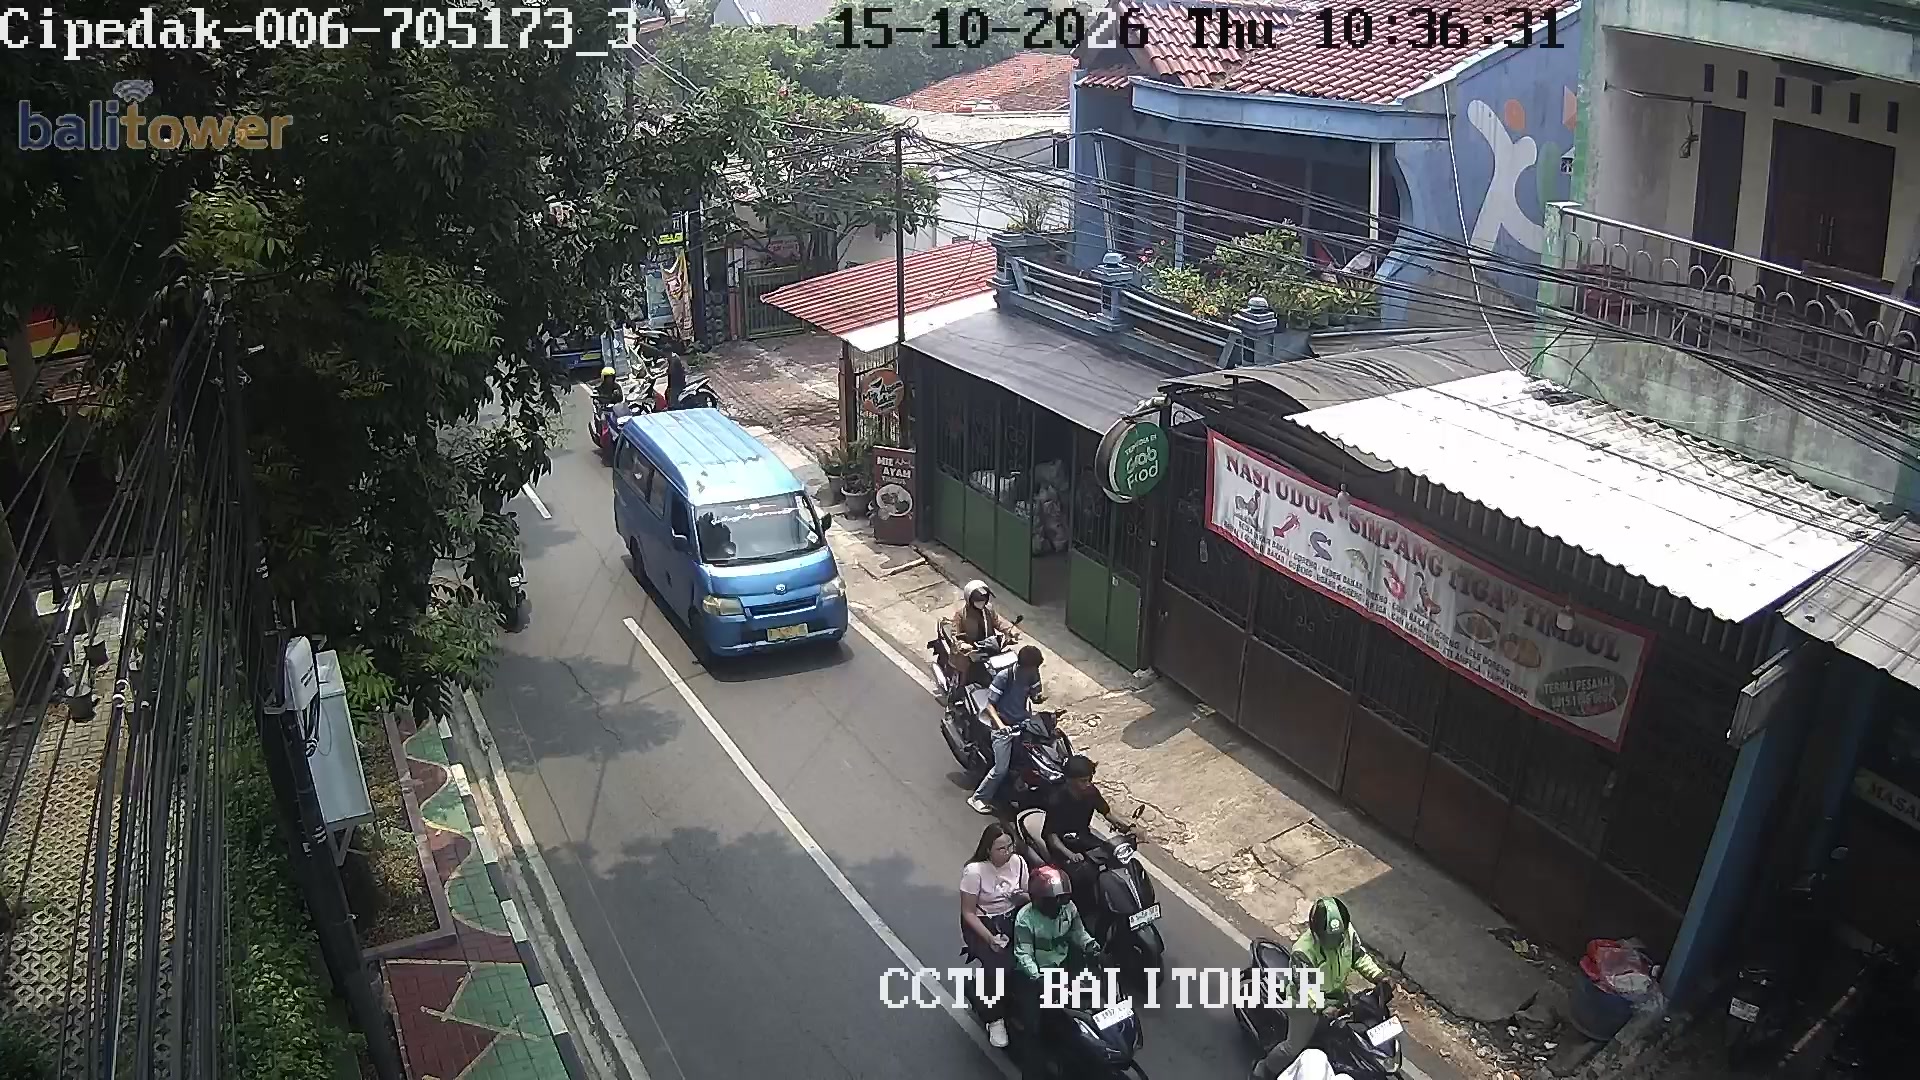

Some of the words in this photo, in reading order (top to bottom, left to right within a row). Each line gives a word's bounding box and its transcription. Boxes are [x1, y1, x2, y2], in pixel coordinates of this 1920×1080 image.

[876, 456, 894, 467] MIE
[882, 467, 912, 479] AYAM
[1126, 446, 1158, 475] Grab
[1126, 459, 1159, 491] Food
[1226, 455, 1271, 494] NASI
[1275, 480, 1335, 524] UDUK
